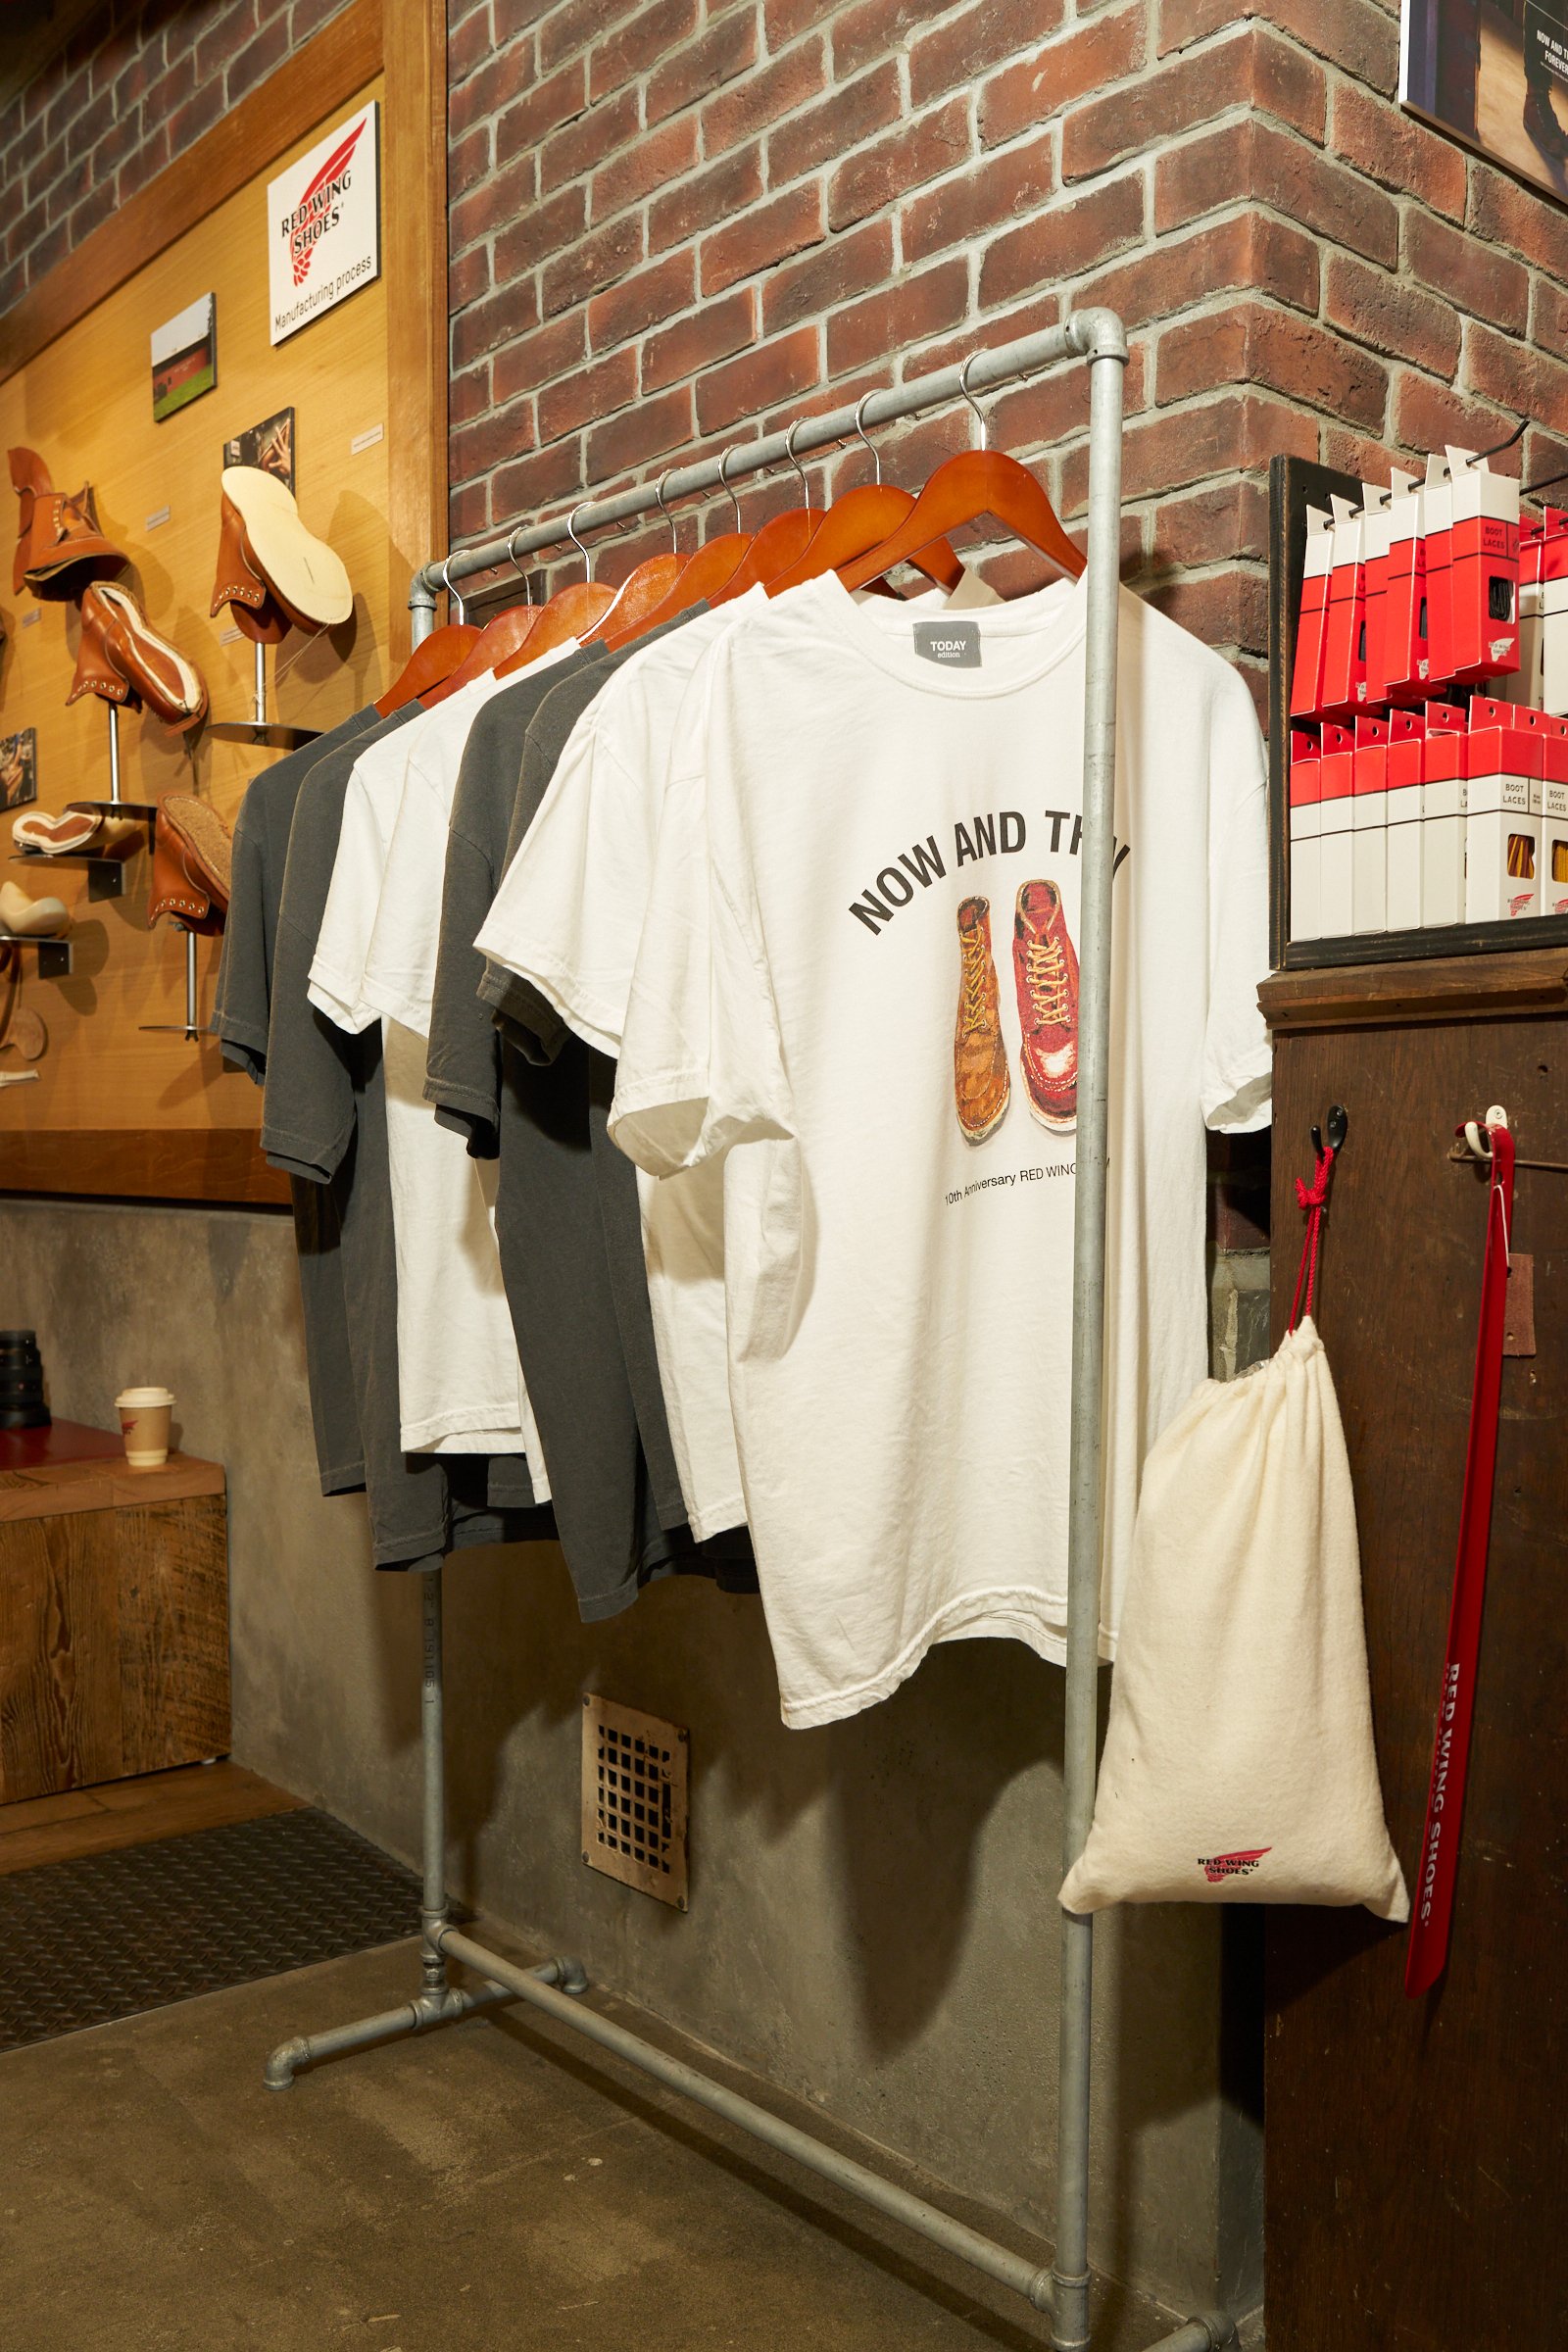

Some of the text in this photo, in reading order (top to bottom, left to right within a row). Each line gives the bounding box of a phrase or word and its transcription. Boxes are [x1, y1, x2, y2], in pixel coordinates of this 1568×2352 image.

[1537, 29, 1550, 47] NOW
[1550, 40, 1563, 56] AND
[281, 171, 352, 237] RED WING
[294, 206, 341, 254] SHOES
[275, 256, 371, 331] Manufacturing process
[1485, 526, 1502, 536] BOOT
[1483, 539, 1504, 550] LACES
[930, 641, 966, 652] TODAY
[1505, 784, 1524, 793] BOOT
[1549, 790, 1565, 799] BOOT
[1502, 795, 1526, 805] LACES
[1547, 802, 1567, 811] LACES
[849, 835, 947, 936] NOW
[955, 810, 1027, 868] AND
[945, 1190, 962, 1206] 10th
[964, 1174, 1016, 1199] Anniversary
[1019, 1167, 1044, 1182] RED
[1421, 1663, 1460, 1921] RED WING SHOES
